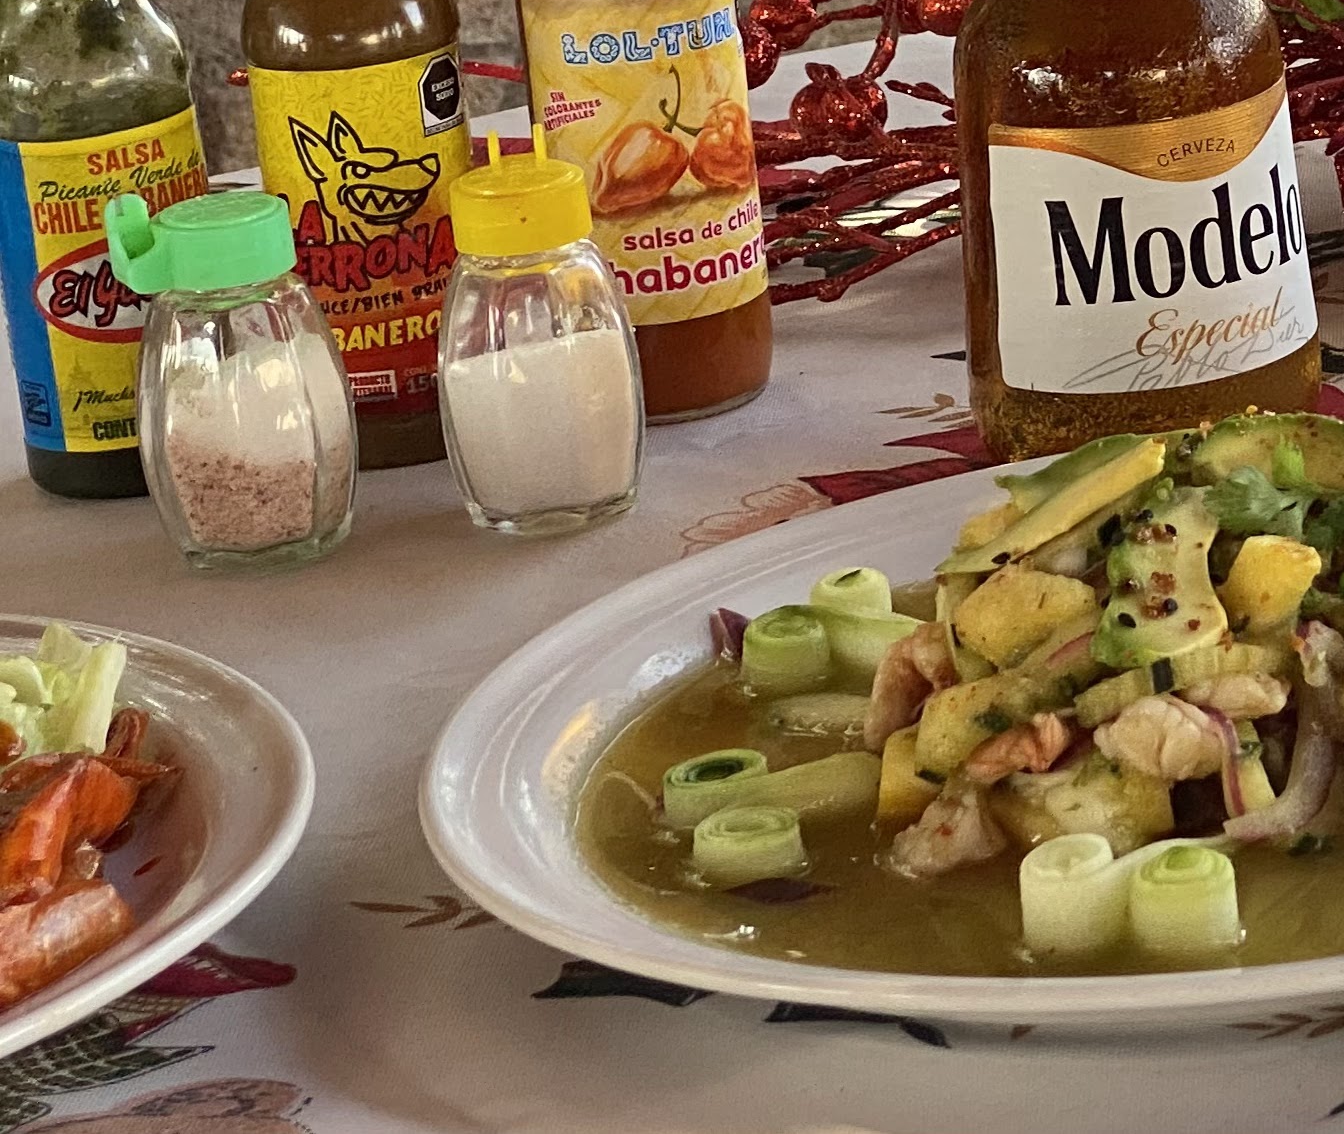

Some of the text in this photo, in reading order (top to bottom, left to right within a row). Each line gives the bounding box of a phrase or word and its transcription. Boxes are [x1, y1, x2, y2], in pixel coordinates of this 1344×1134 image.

[543, 98, 602, 118] COLORANTES
[86, 138, 166, 176] SALSA
[1156, 137, 1236, 168] CERVEZA
[128, 156, 184, 189] Verde
[33, 197, 103, 235] CHILE
[623, 199, 759, 252] salsa de chile
[1044, 162, 1302, 306] Modelo
[1135, 285, 1284, 366] Especial
